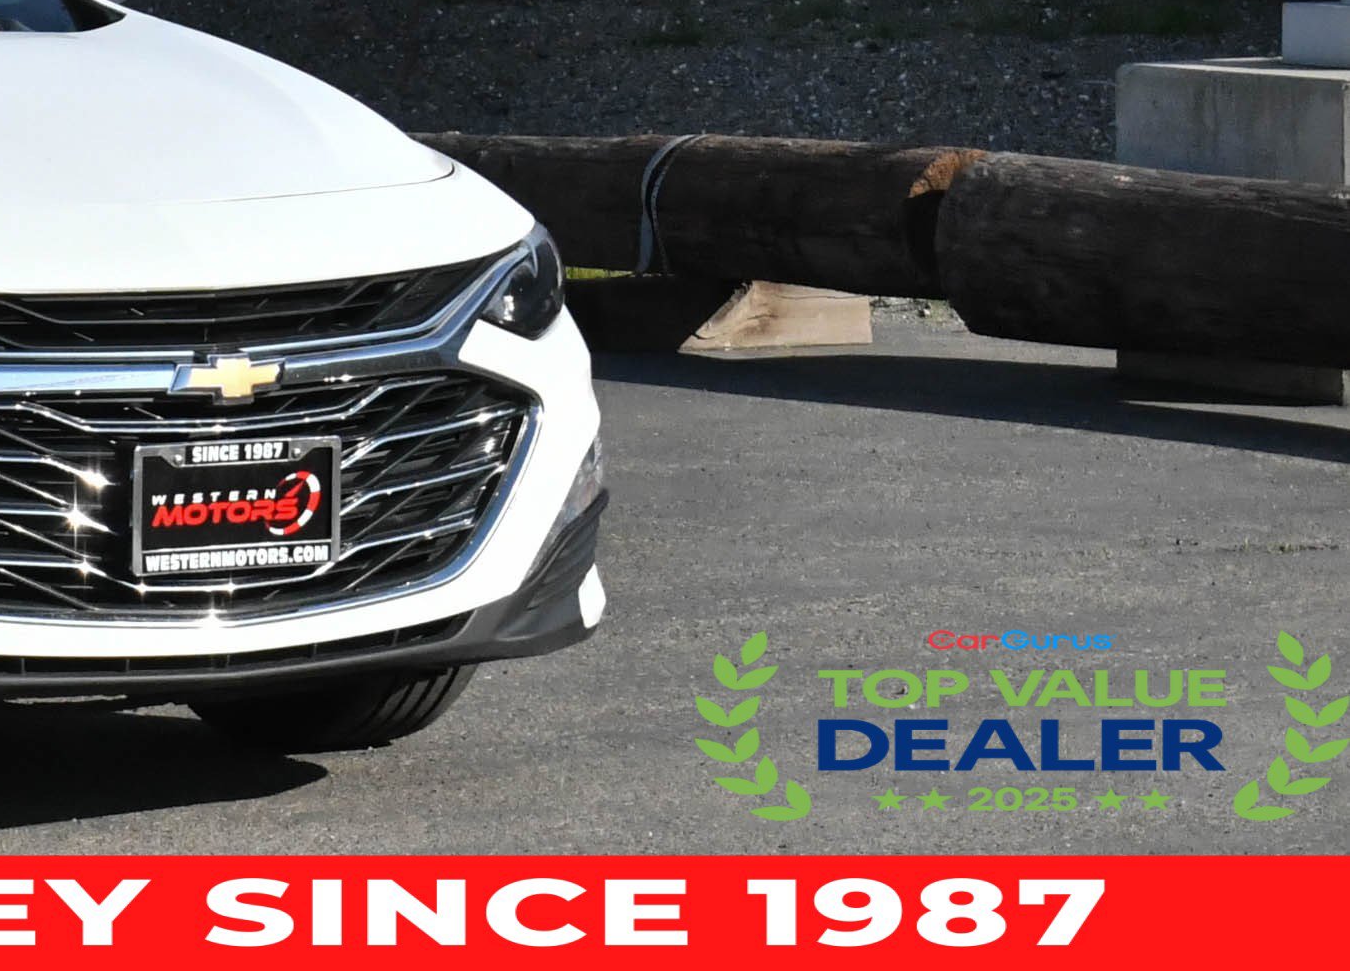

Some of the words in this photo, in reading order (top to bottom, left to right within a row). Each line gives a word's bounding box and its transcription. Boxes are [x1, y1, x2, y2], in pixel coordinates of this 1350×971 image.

[192, 444, 239, 463] SINCE
[244, 442, 283, 460] 1987
[151, 488, 277, 506] WESTERN
[151, 497, 300, 527] MOTORS
[145, 544, 329, 572] WESTERNMOTORS.COM
